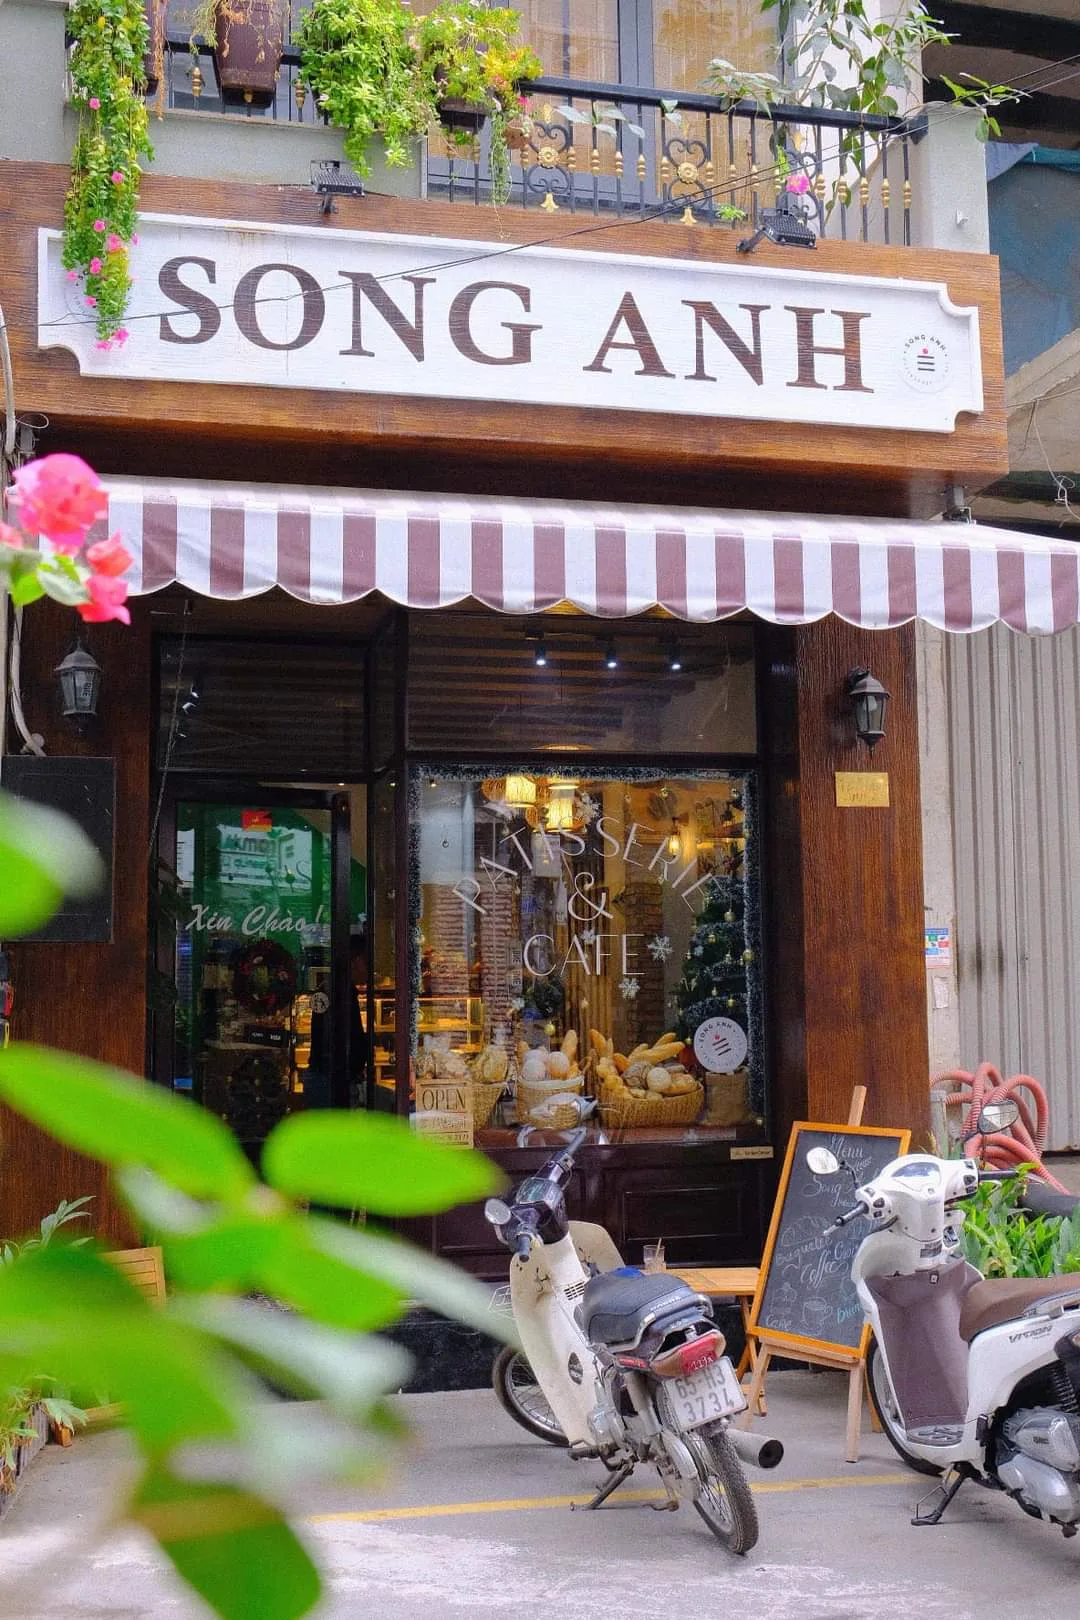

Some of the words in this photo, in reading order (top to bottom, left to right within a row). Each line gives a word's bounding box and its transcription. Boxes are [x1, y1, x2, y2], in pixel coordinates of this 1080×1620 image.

[157, 255, 543, 366] SONG
[582, 291, 875, 394] ANH
[904, 334, 926, 348] SONG
[929, 336, 946, 351] ANH
[452, 816, 724, 914] PATISSERIE
[184, 903, 233, 931] Xin
[567, 871, 614, 921] &
[523, 934, 646, 977] CAFE
[422, 1088, 467, 1111] OPEN
